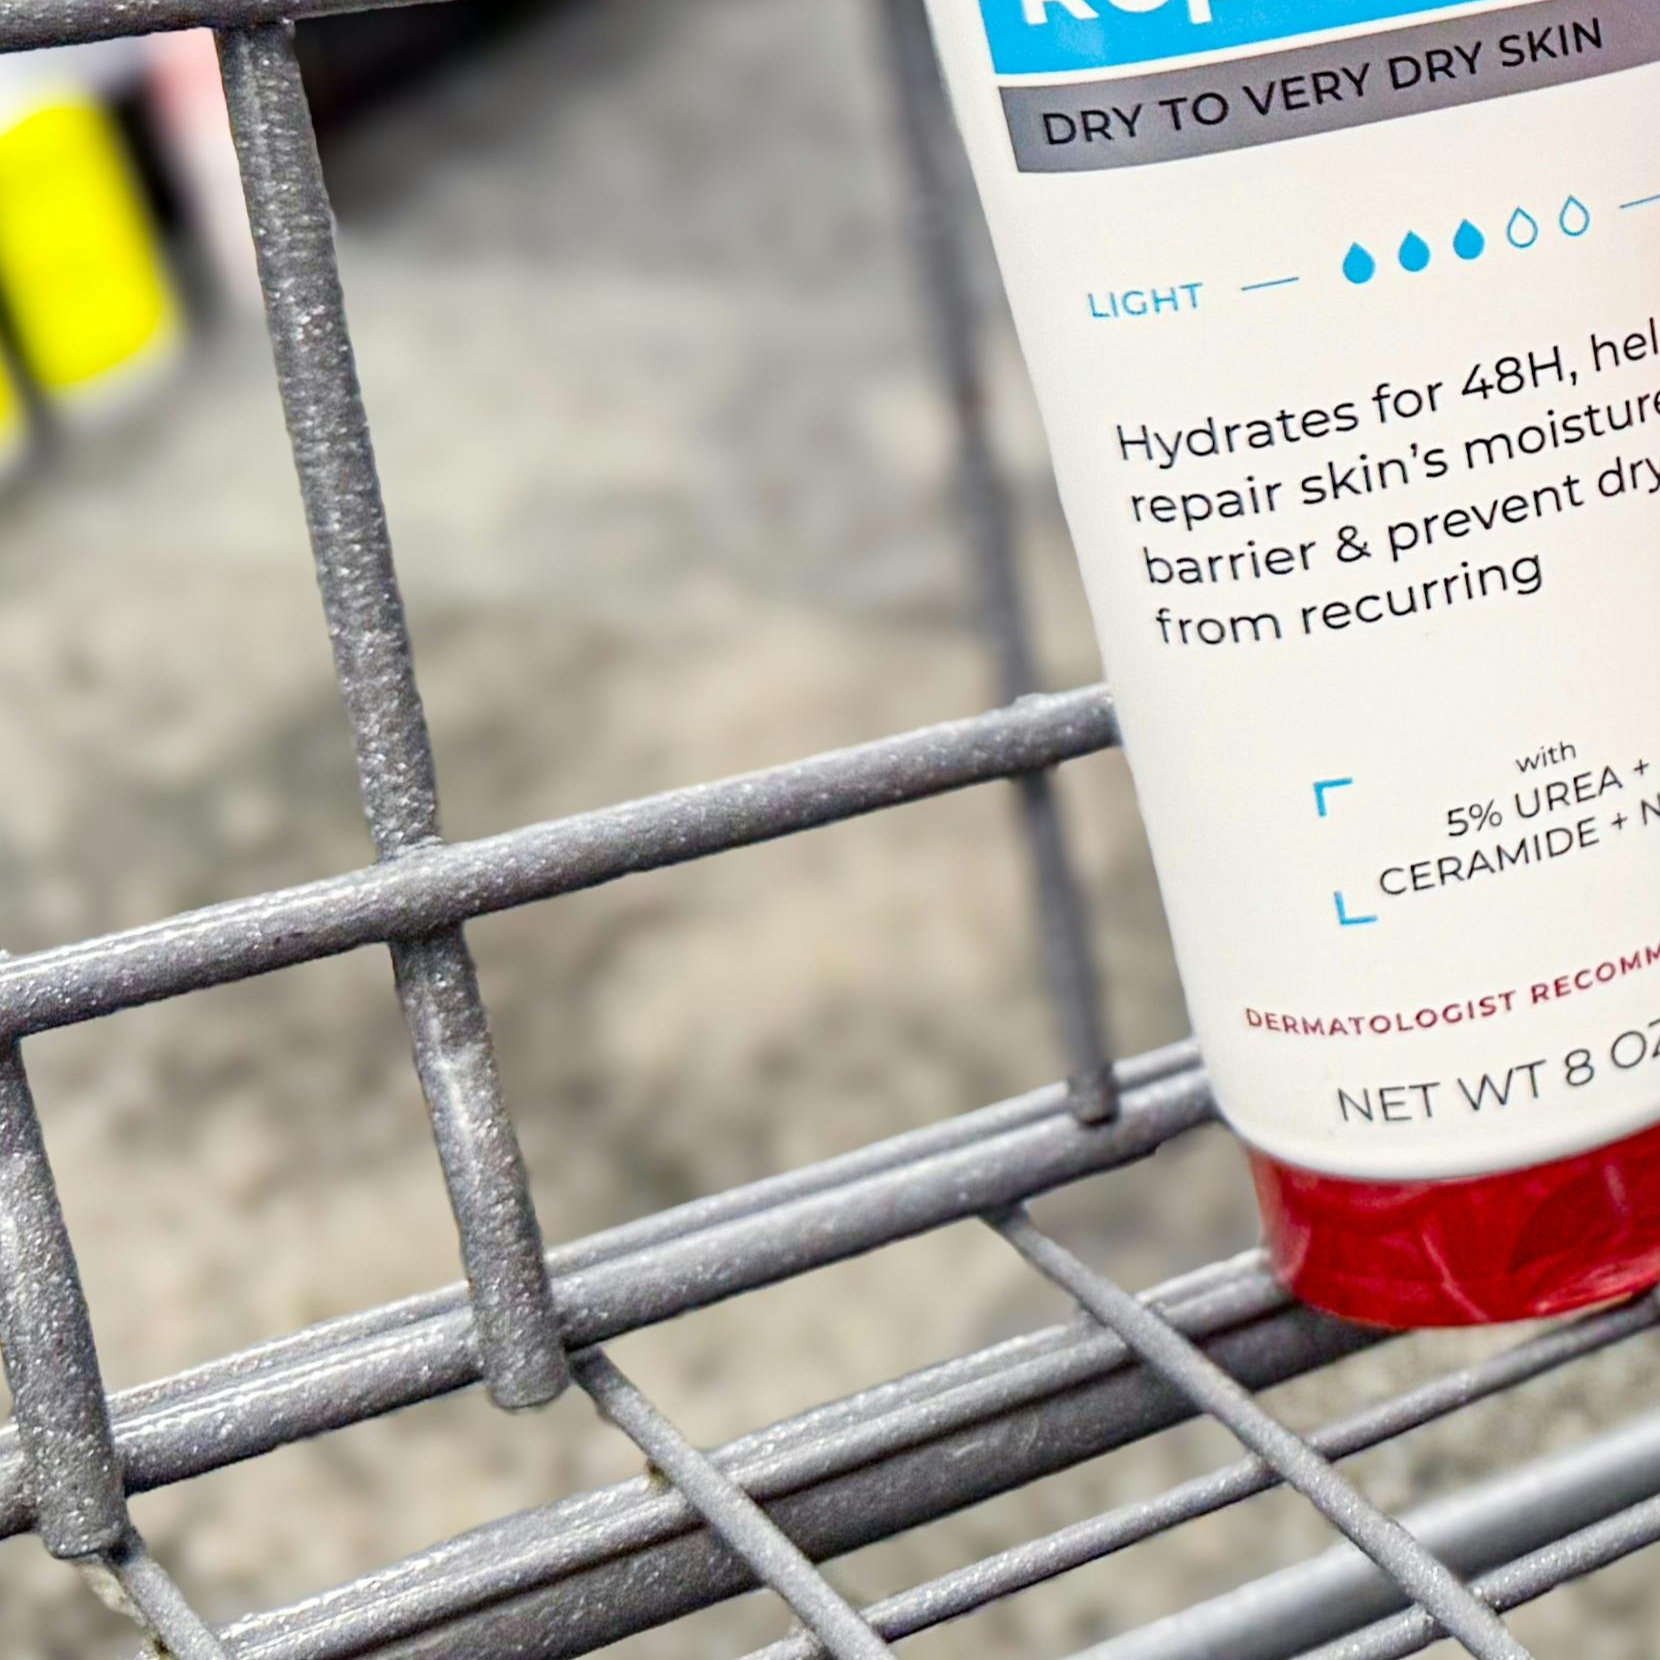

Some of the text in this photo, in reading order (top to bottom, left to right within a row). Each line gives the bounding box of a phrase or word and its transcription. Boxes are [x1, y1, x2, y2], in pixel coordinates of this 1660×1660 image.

[1043, 17, 1603, 147] DRY TO VERY DRY SKIN
[1088, 284, 1202, 319] LIGHT
[1116, 399, 1360, 469] Hydrates
[1371, 382, 1444, 425] for
[1460, 345, 1579, 401] 48H,
[1130, 479, 1283, 531] repair
[1144, 535, 1316, 586] barrier
[1336, 527, 1371, 563] &
[1387, 473, 1584, 561] prevent
[1157, 553, 1544, 646] from recurring
[1515, 740, 1577, 773] with
[1447, 759, 1650, 837] 5% UREA +
[1379, 817, 1600, 895] CERAMIDE
[1610, 812, 1629, 830] +
[1245, 991, 1518, 1036] DERMATOLOGIST
[1339, 1082, 1441, 1122] NET
[1457, 1061, 1547, 1111] WT
[1564, 1049, 1595, 1086] 8
